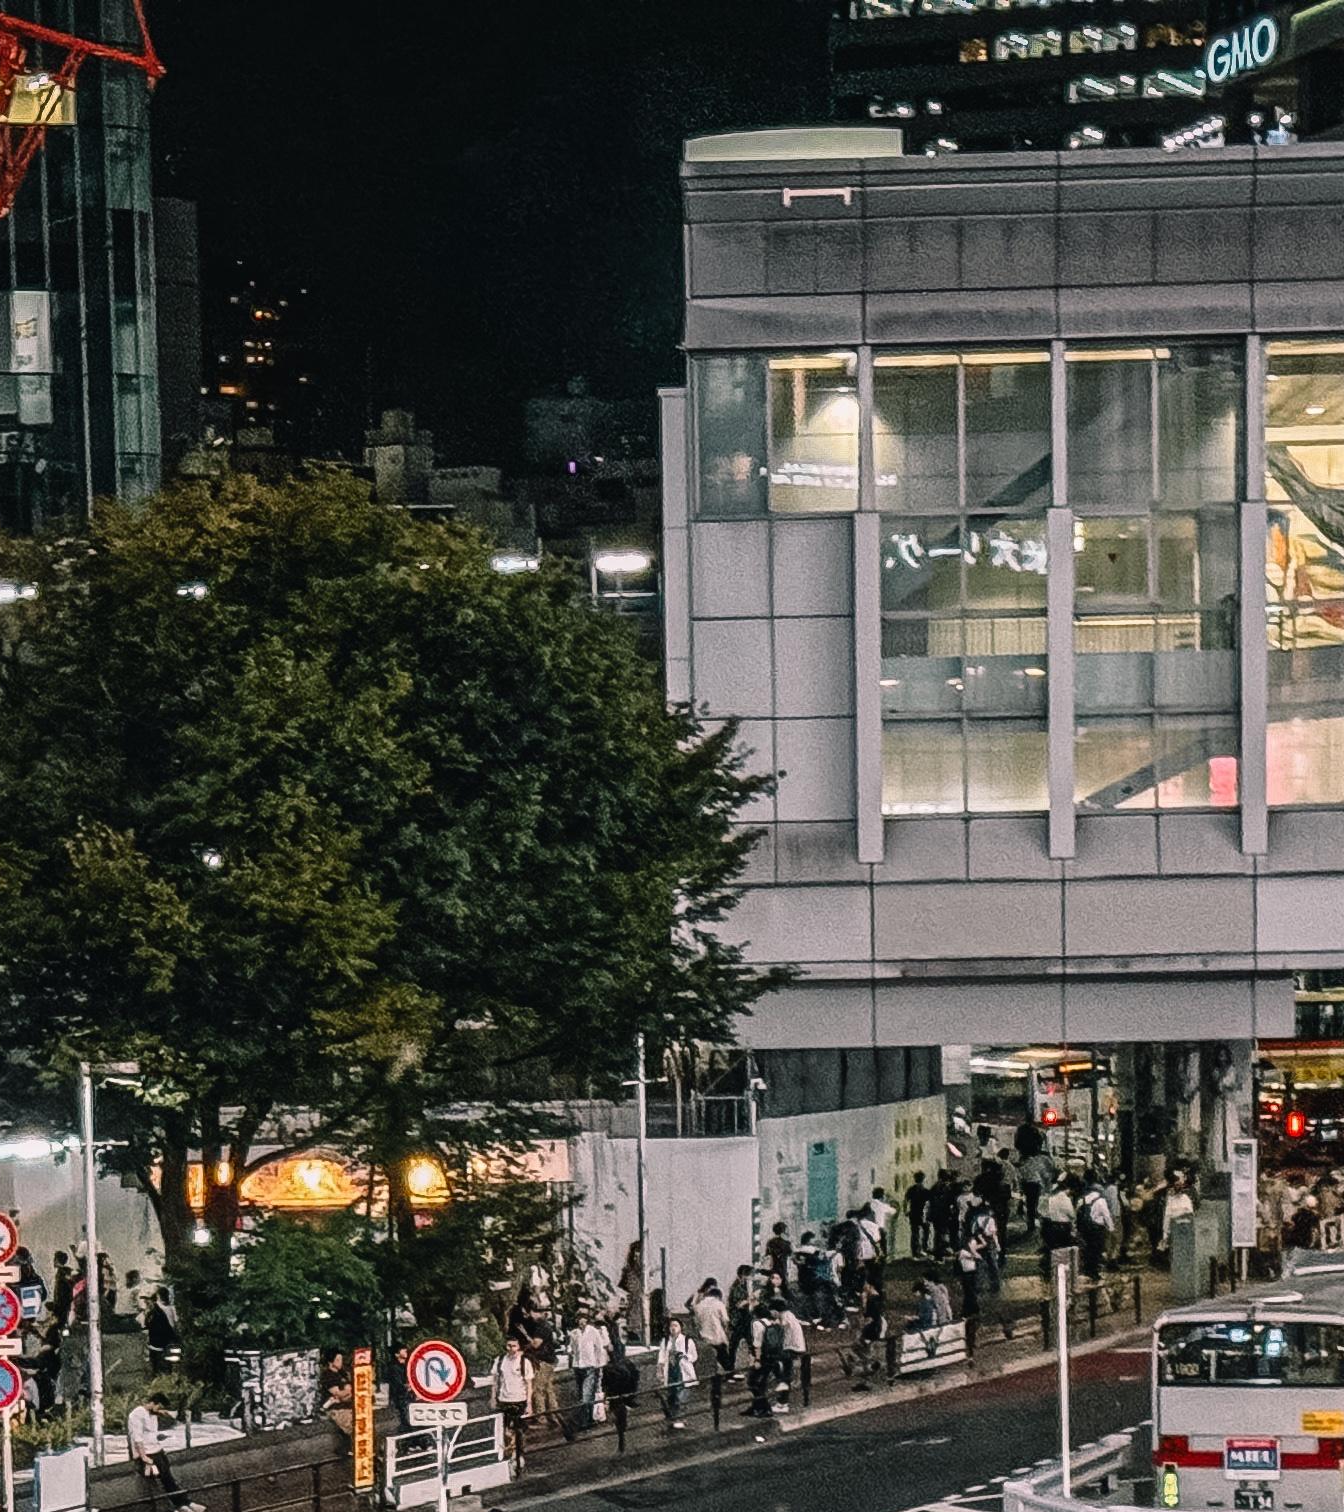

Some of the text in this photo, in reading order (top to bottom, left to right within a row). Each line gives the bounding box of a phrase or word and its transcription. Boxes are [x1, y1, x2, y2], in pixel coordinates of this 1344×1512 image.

[1207, 18, 1276, 82] GMO
[414, 1408, 462, 1422] ここまで
